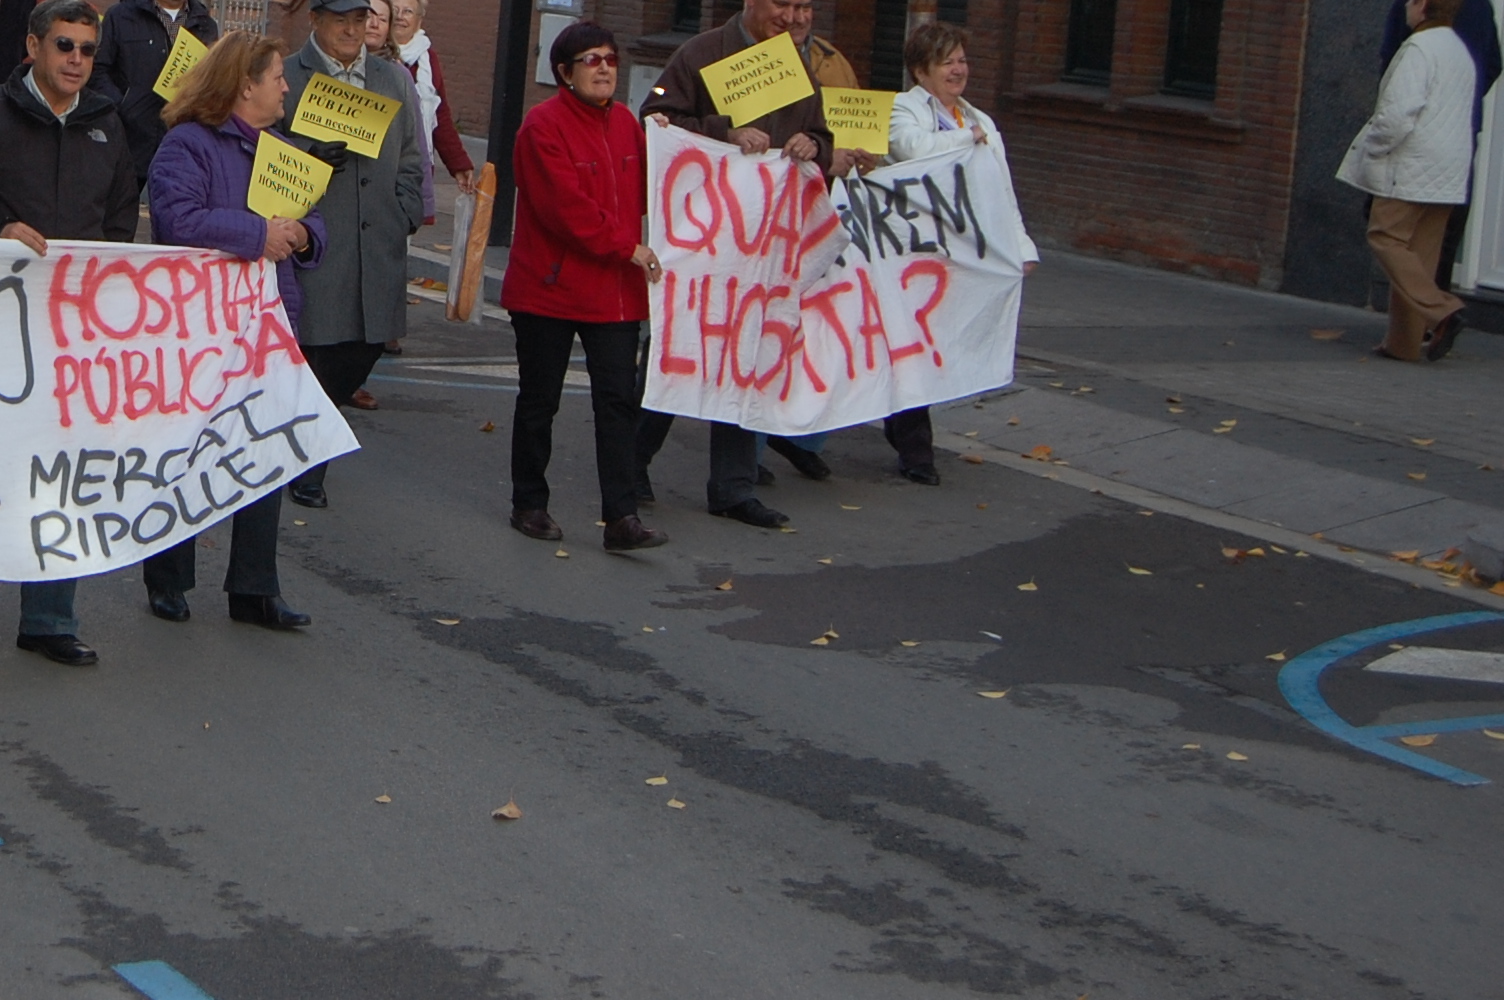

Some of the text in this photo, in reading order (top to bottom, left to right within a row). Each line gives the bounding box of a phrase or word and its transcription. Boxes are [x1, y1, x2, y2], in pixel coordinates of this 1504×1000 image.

[162, 40, 187, 88] HOSPITAL
[725, 58, 784, 90] PROMESES
[729, 50, 769, 74] MENYS
[723, 77, 777, 105] HOSPITAL
[838, 95, 872, 105] MENYS
[302, 110, 377, 142] una necessitat
[828, 107, 878, 118] PROMESES
[267, 162, 314, 194] PROMESES
[278, 152, 311, 175] MENYS
[258, 174, 301, 206] HOSPITAL
[48, 251, 281, 348] HOSPITAL
[30, 389, 265, 502] MERCAT
[30, 413, 319, 571] RIPOLLET
